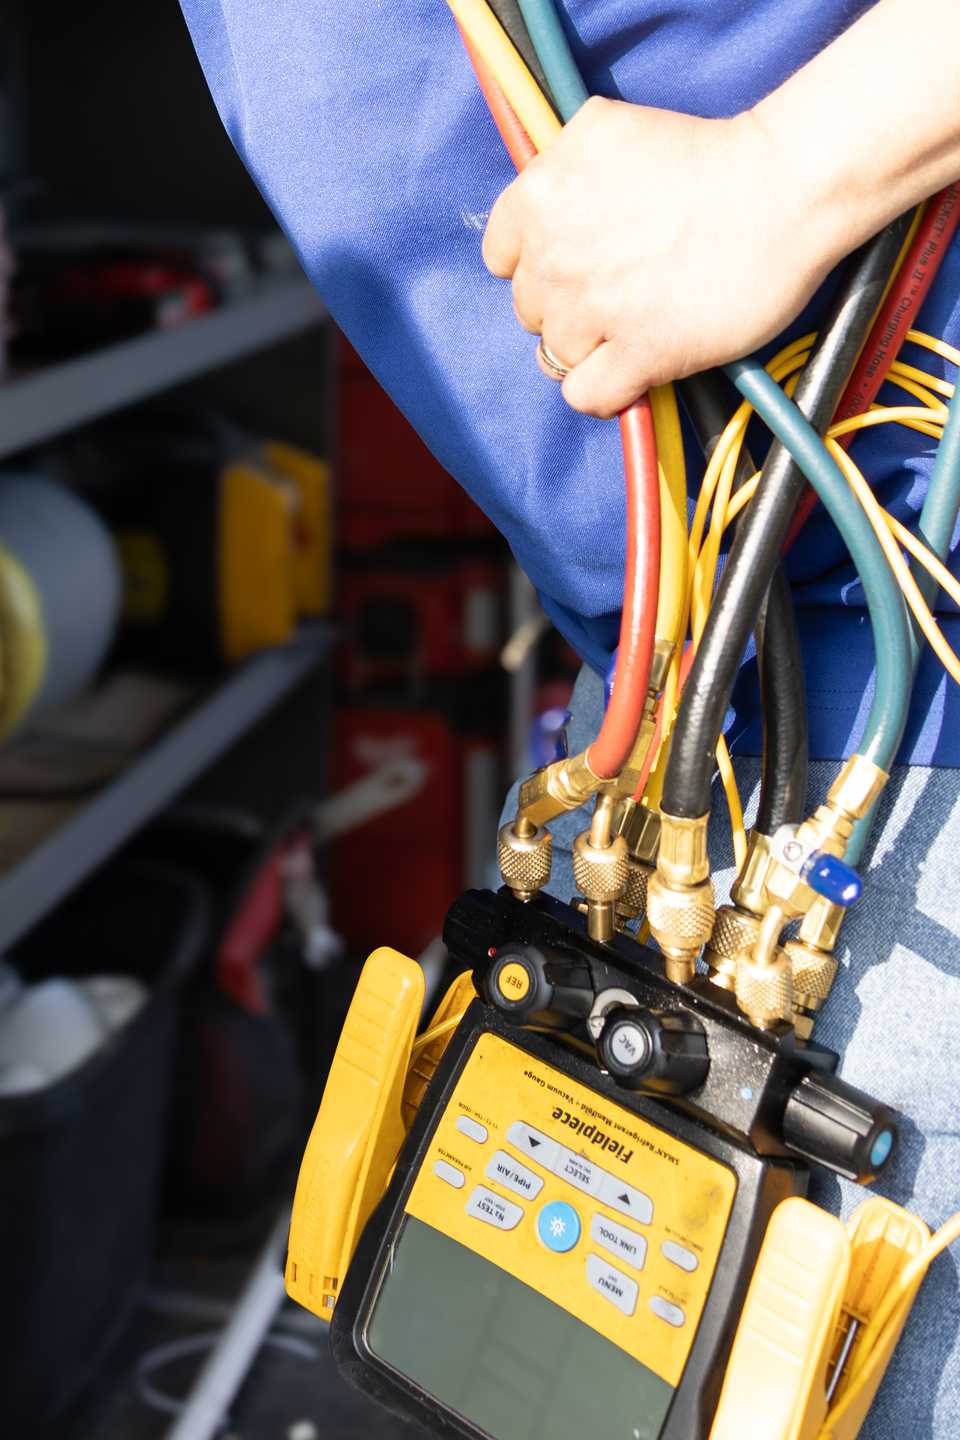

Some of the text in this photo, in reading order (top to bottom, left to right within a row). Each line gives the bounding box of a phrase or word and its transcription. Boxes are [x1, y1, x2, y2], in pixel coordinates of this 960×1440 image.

[919, 240, 938, 266] Plus
[885, 295, 913, 348] Charging
[865, 349, 886, 378] Hose
[505, 975, 523, 990] REF
[618, 1033, 636, 1057] VAC
[524, 1070, 546, 1088] Gauge
[547, 1084, 575, 1105] Vacuum
[580, 1103, 613, 1126] Manifold
[552, 1107, 634, 1164] Fieldpiece
[614, 1120, 655, 1152] Refrigerant
[564, 1165, 590, 1184] SELECT
[476, 1200, 494, 1217] TEST
[599, 1226, 637, 1255] LINK TOOL
[598, 1277, 623, 1297] MENU
